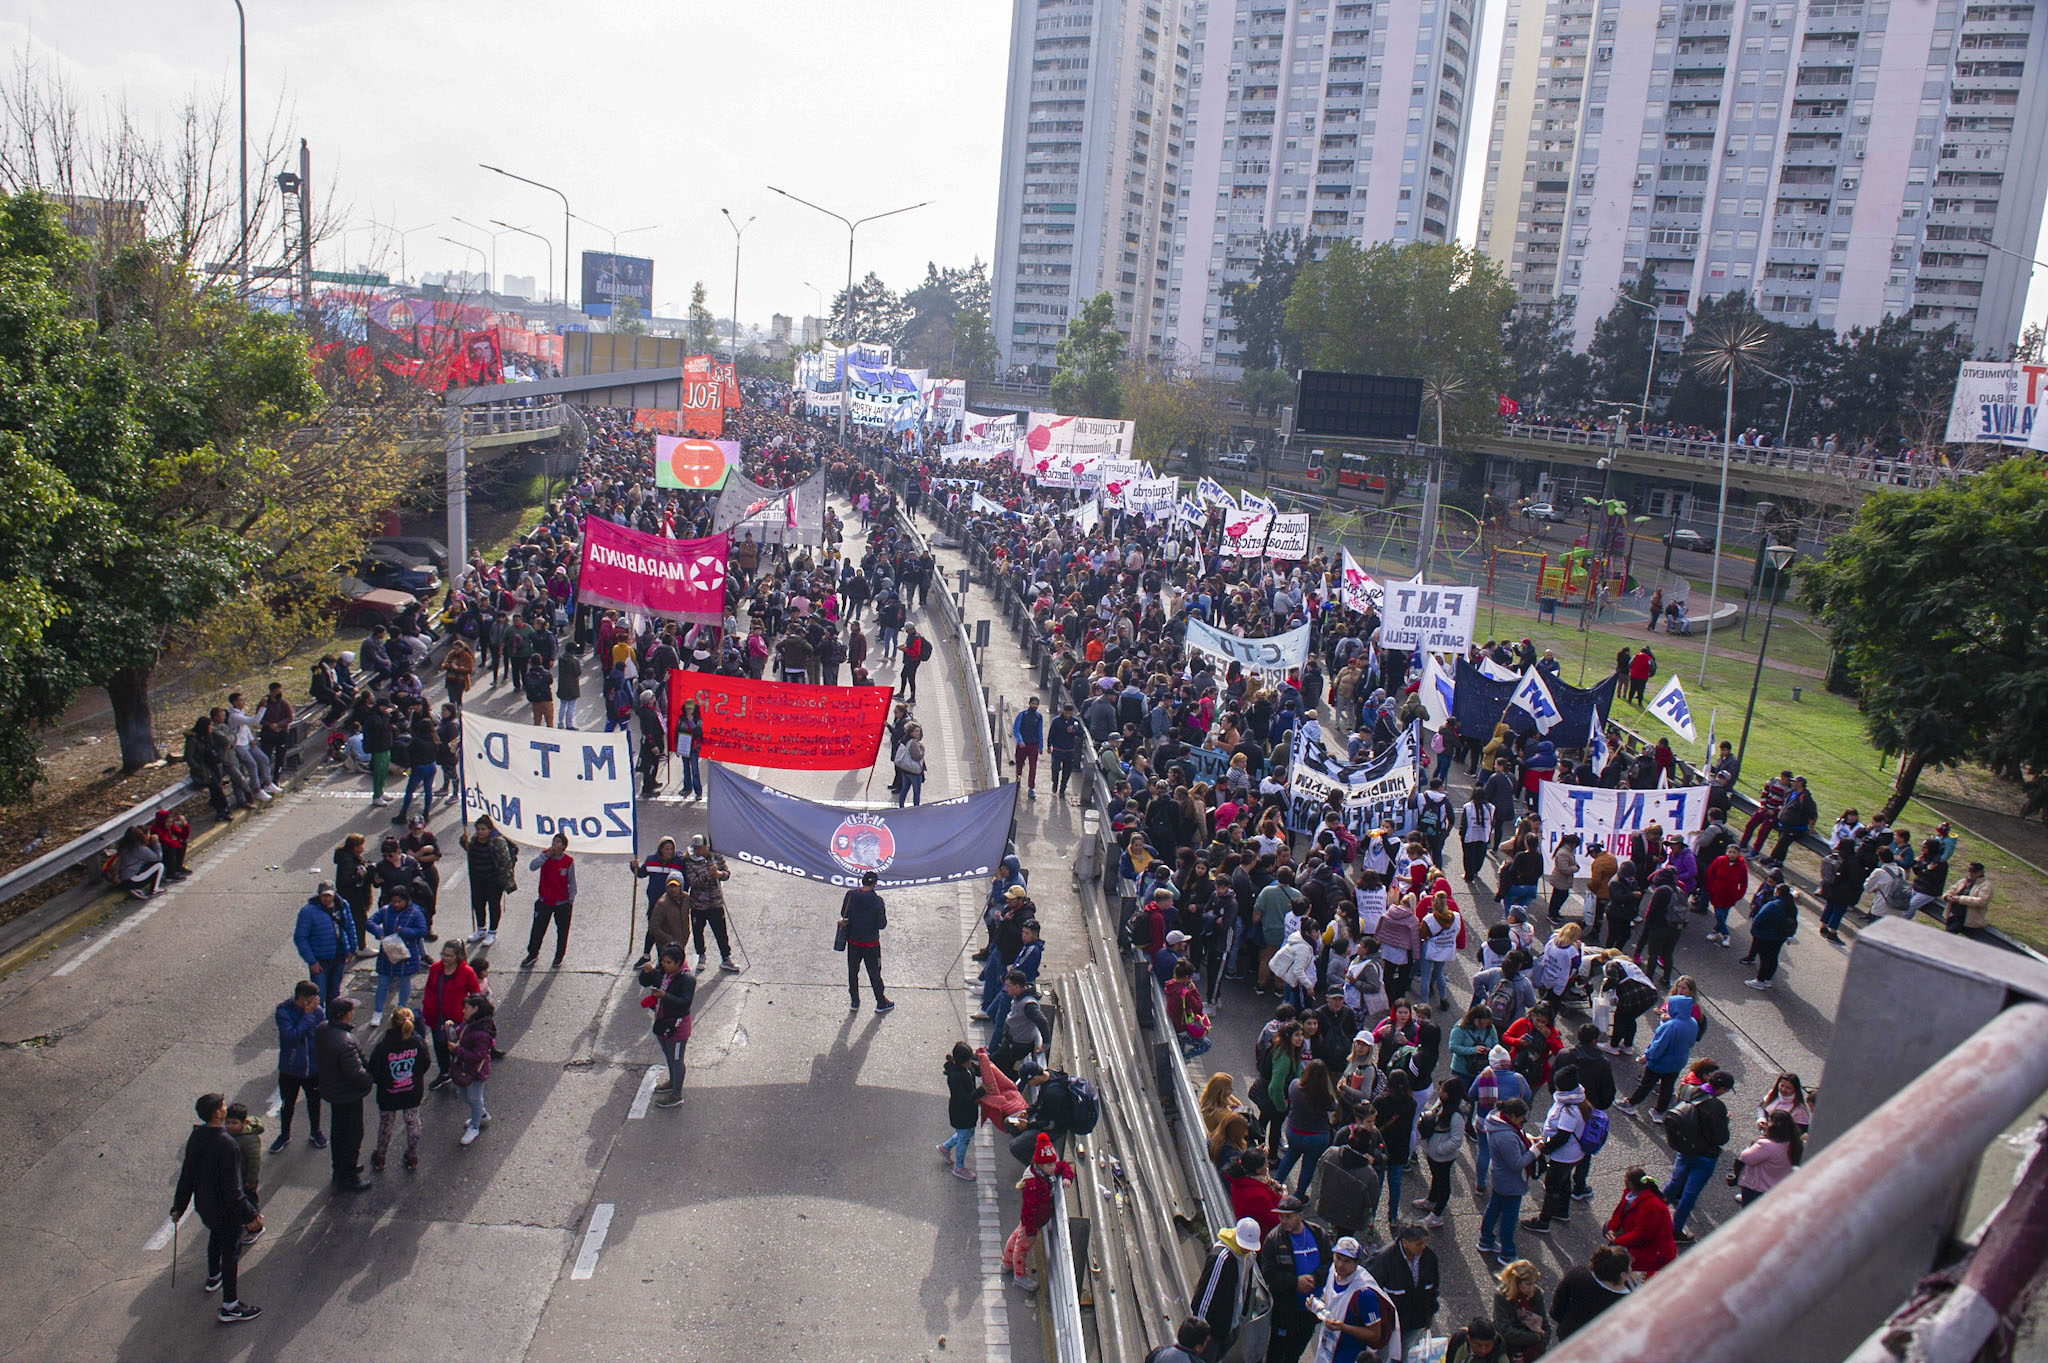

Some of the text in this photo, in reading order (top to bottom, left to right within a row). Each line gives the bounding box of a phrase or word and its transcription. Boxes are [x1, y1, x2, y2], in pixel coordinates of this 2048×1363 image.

[595, 279, 643, 298] BARABRAVA
[1180, 501, 1203, 521] FNT
[1244, 494, 1264, 510] FNT
